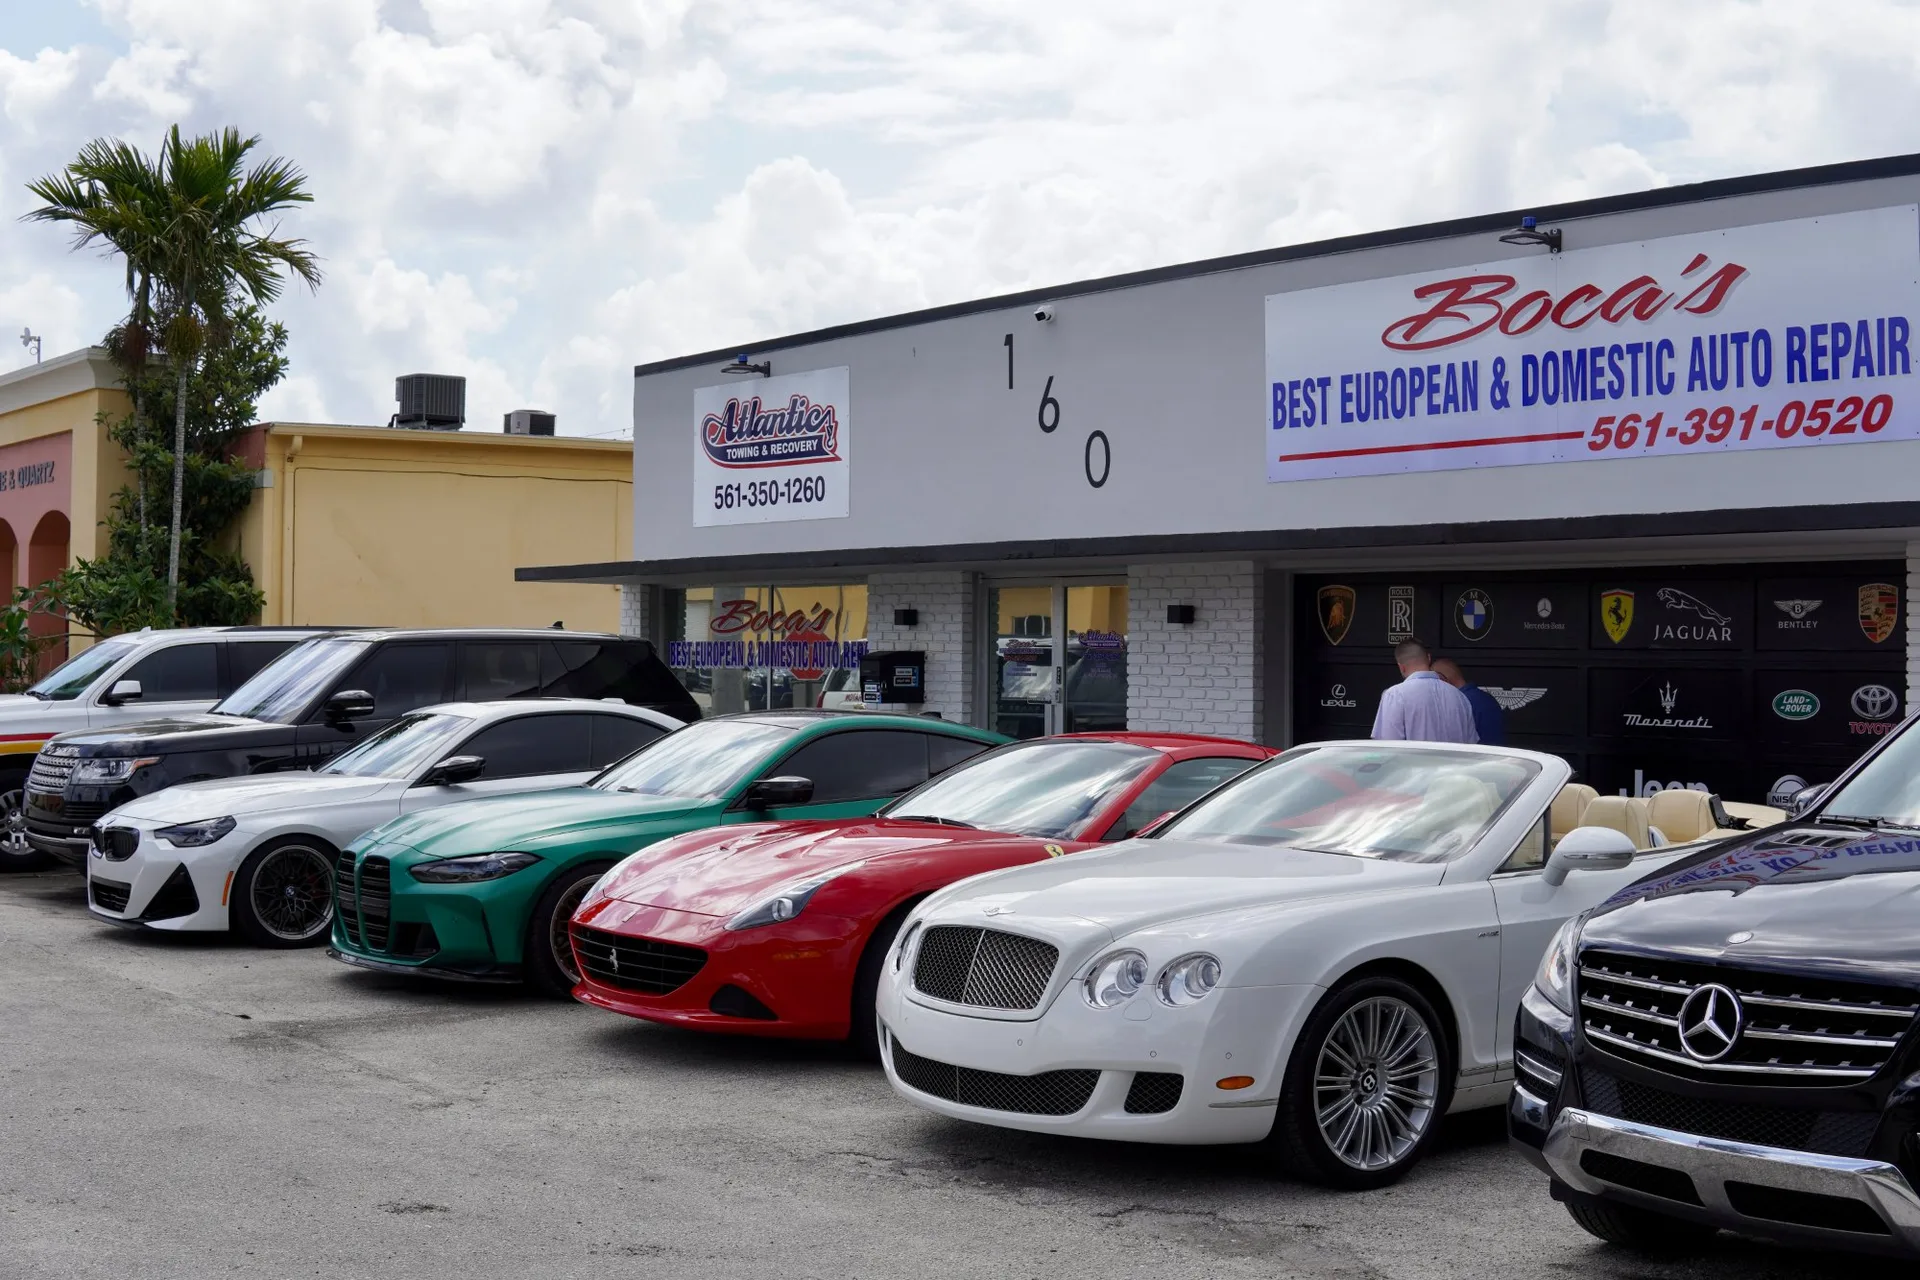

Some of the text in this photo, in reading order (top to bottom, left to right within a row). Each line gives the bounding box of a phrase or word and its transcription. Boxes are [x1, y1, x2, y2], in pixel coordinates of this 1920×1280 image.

[1381, 253, 1748, 352] Boca's
[1272, 316, 1912, 430] BEST EUROPEAN & DOMESTIC AUTO REPAIR
[703, 395, 834, 443] Atlantic
[1587, 394, 1894, 452] 561-391-0520
[726, 439, 819, 460] TOWING & RECOVERY
[17, 461, 55, 488] QUARTZ
[714, 475, 826, 510] 561-350-1260
[710, 600, 835, 634] Boca's
[1523, 621, 1566, 631] Mercedes-Benz
[1778, 620, 1818, 629] BENTLEY
[1653, 624, 1732, 642] JAGUAR
[669, 641, 692, 668] BEST
[695, 641, 745, 668] EUROPEAN
[747, 641, 755, 668] &
[757, 641, 810, 669] DOMESTIC
[811, 641, 840, 669] AUTO
[1320, 699, 1357, 708] LEXUS
[1782, 695, 1806, 704] LAND
[1783, 703, 1812, 713] ROVER
[1623, 714, 1714, 729] Maserati
[1771, 795, 1790, 804] NIS
